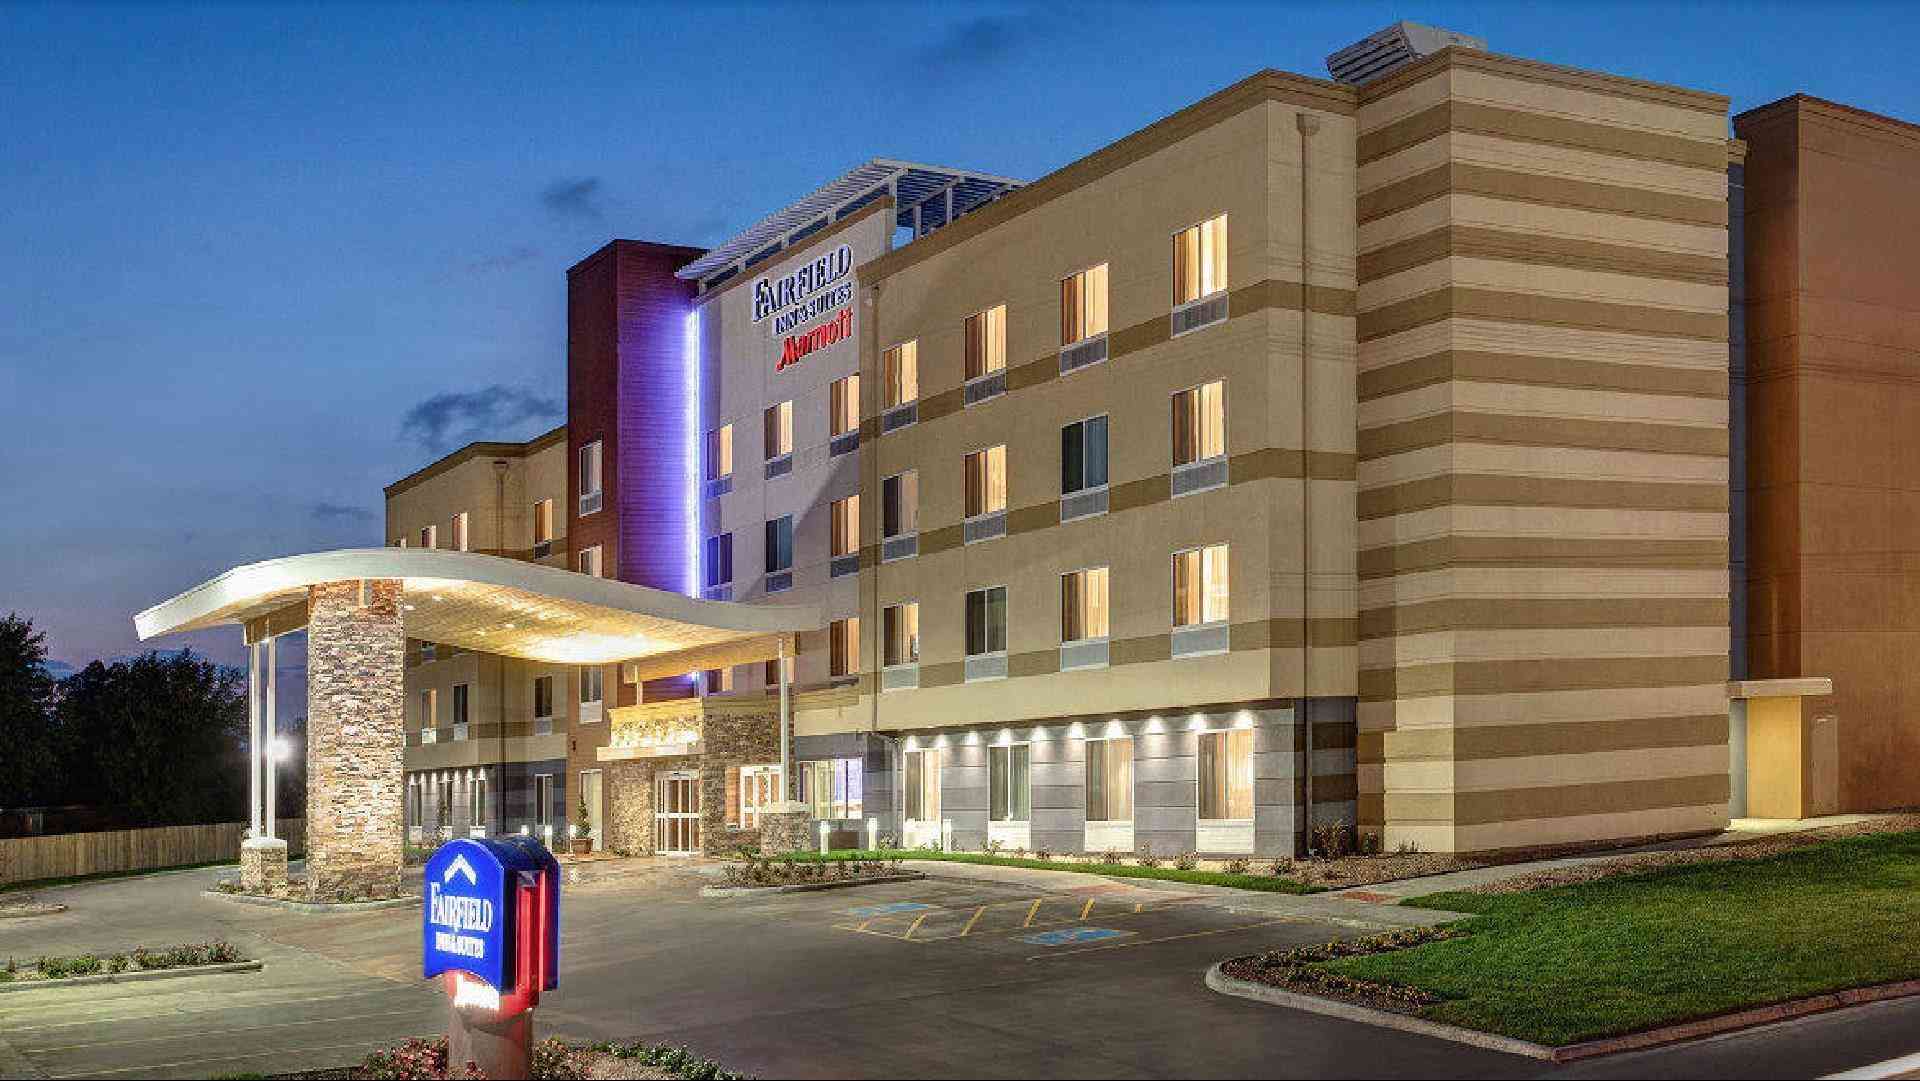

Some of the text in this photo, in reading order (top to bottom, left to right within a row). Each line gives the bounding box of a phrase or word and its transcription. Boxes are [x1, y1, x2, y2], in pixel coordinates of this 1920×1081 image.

[753, 244, 853, 322] FAIRFIELD
[772, 308, 799, 335] INN
[808, 281, 854, 318] SUITES
[776, 304, 853, 371] Marriott
[431, 882, 493, 932] FAIRFIELD
